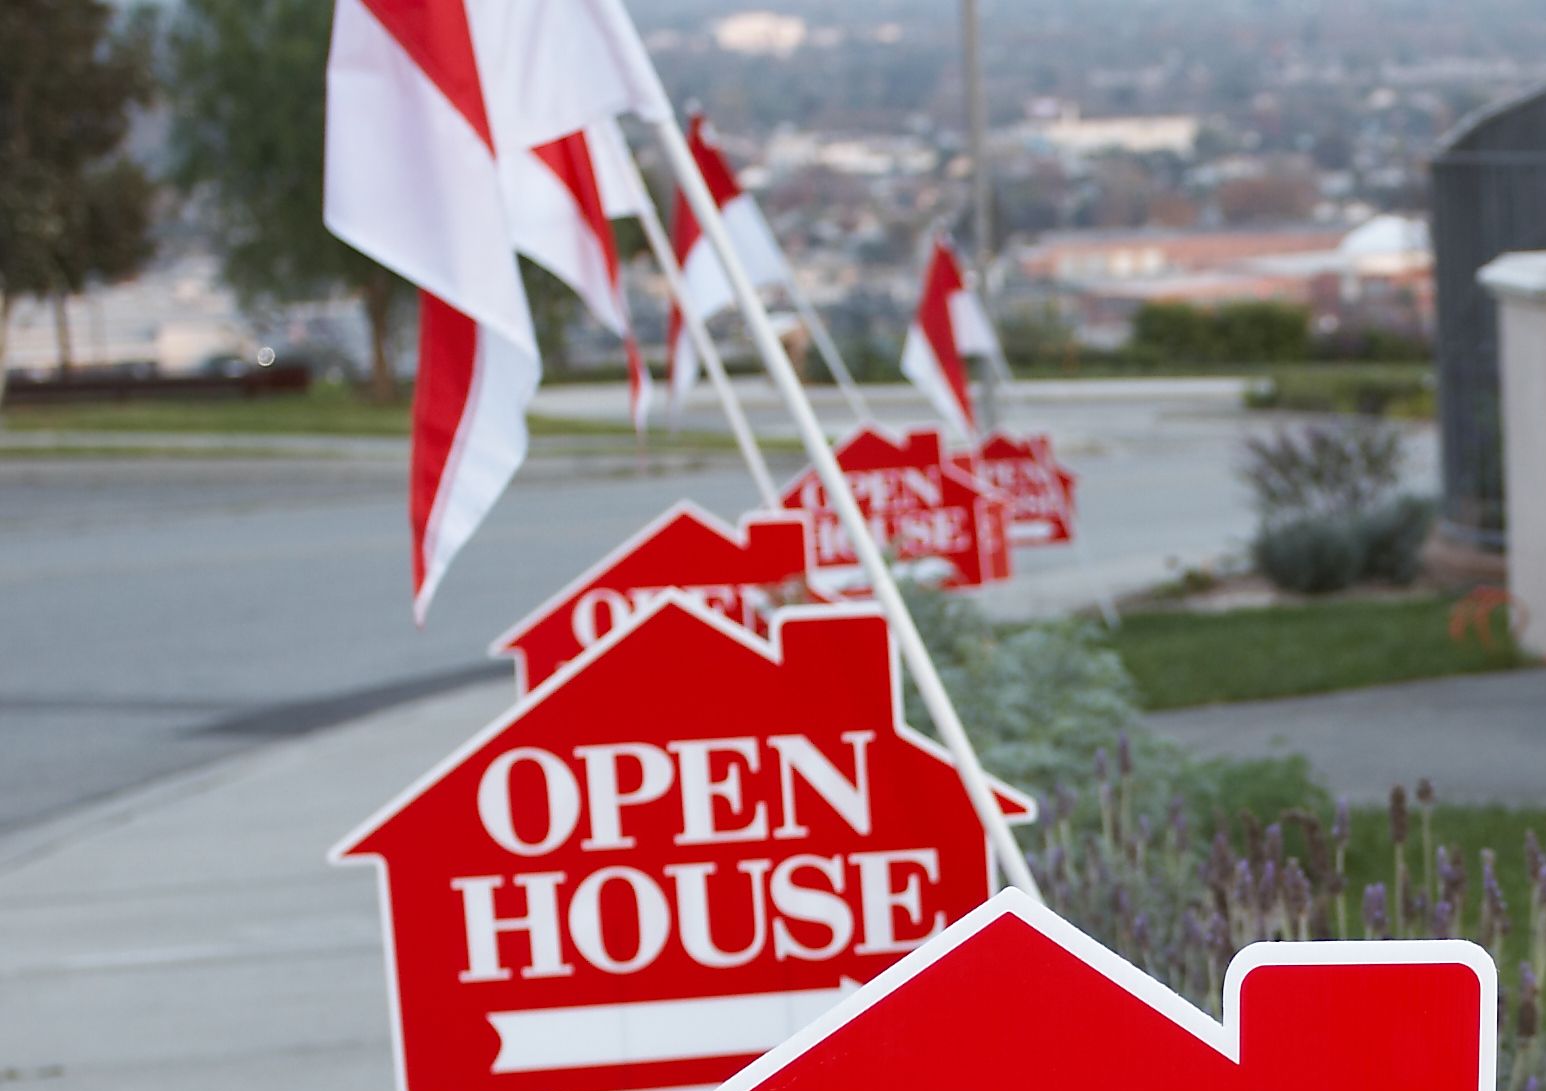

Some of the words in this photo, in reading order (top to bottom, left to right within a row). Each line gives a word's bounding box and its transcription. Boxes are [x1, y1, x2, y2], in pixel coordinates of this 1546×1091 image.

[817, 506, 971, 560] HUSE
[478, 731, 873, 855] OPEN
[452, 849, 944, 982] HOUSE
